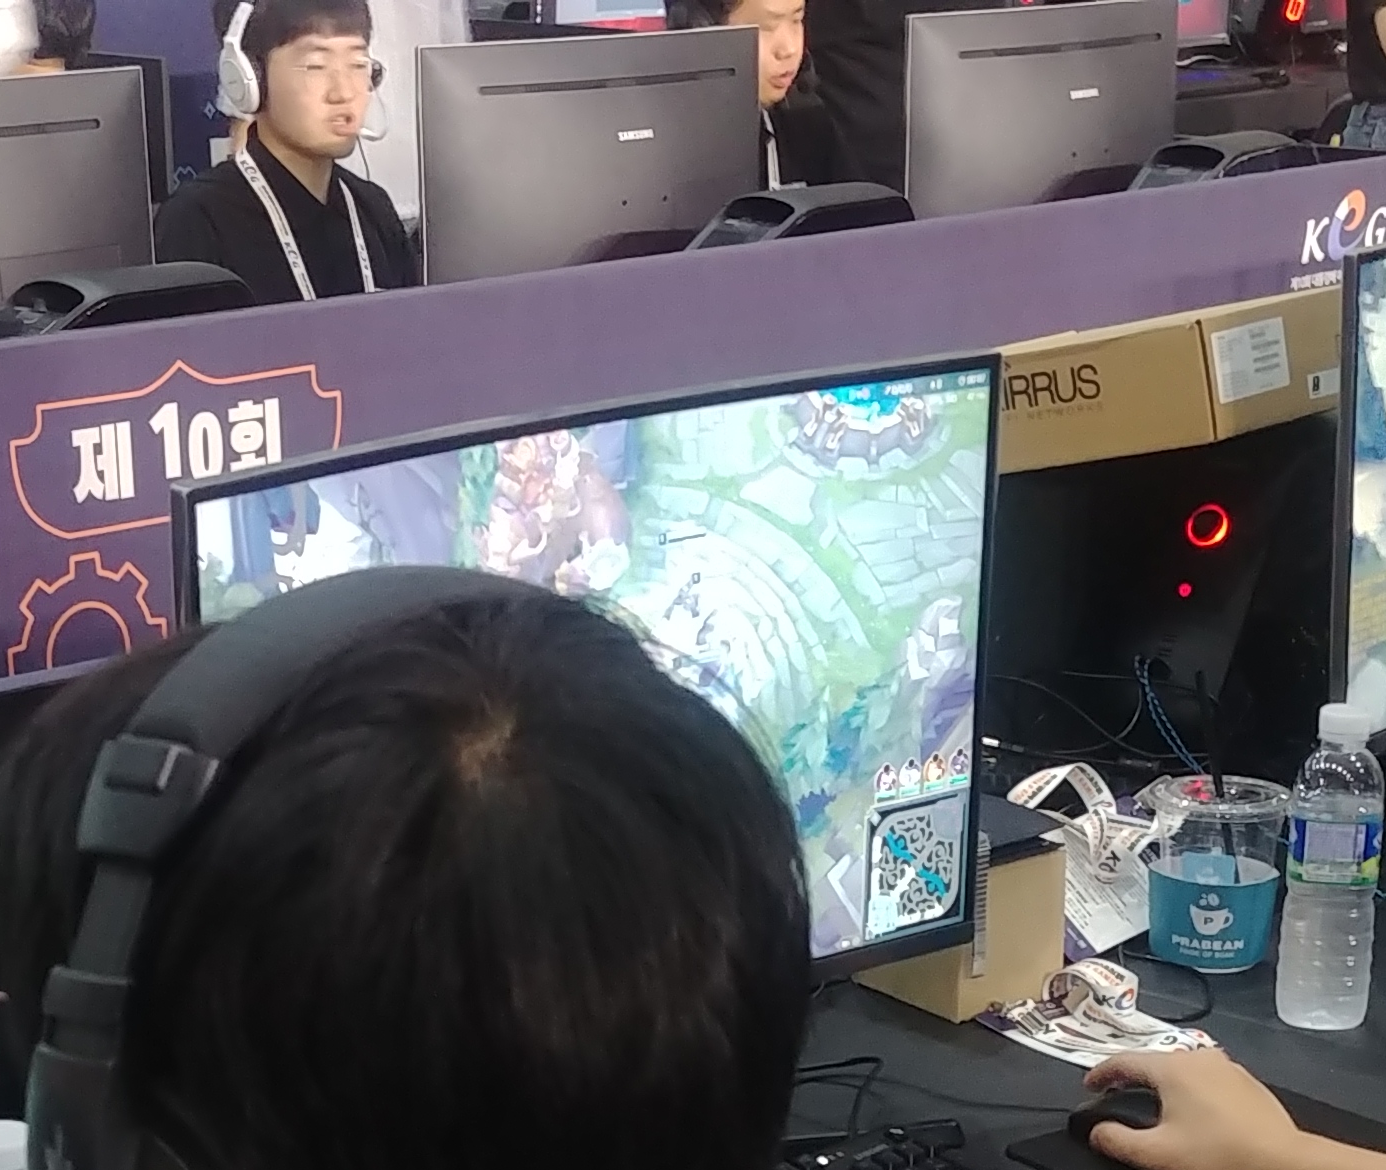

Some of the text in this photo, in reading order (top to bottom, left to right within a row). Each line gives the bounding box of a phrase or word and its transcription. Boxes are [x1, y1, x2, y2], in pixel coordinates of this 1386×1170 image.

[1002, 363, 1101, 411] IRRUS
[71, 397, 282, 504] 제 10회
[1171, 934, 1245, 951] PRABEAN
